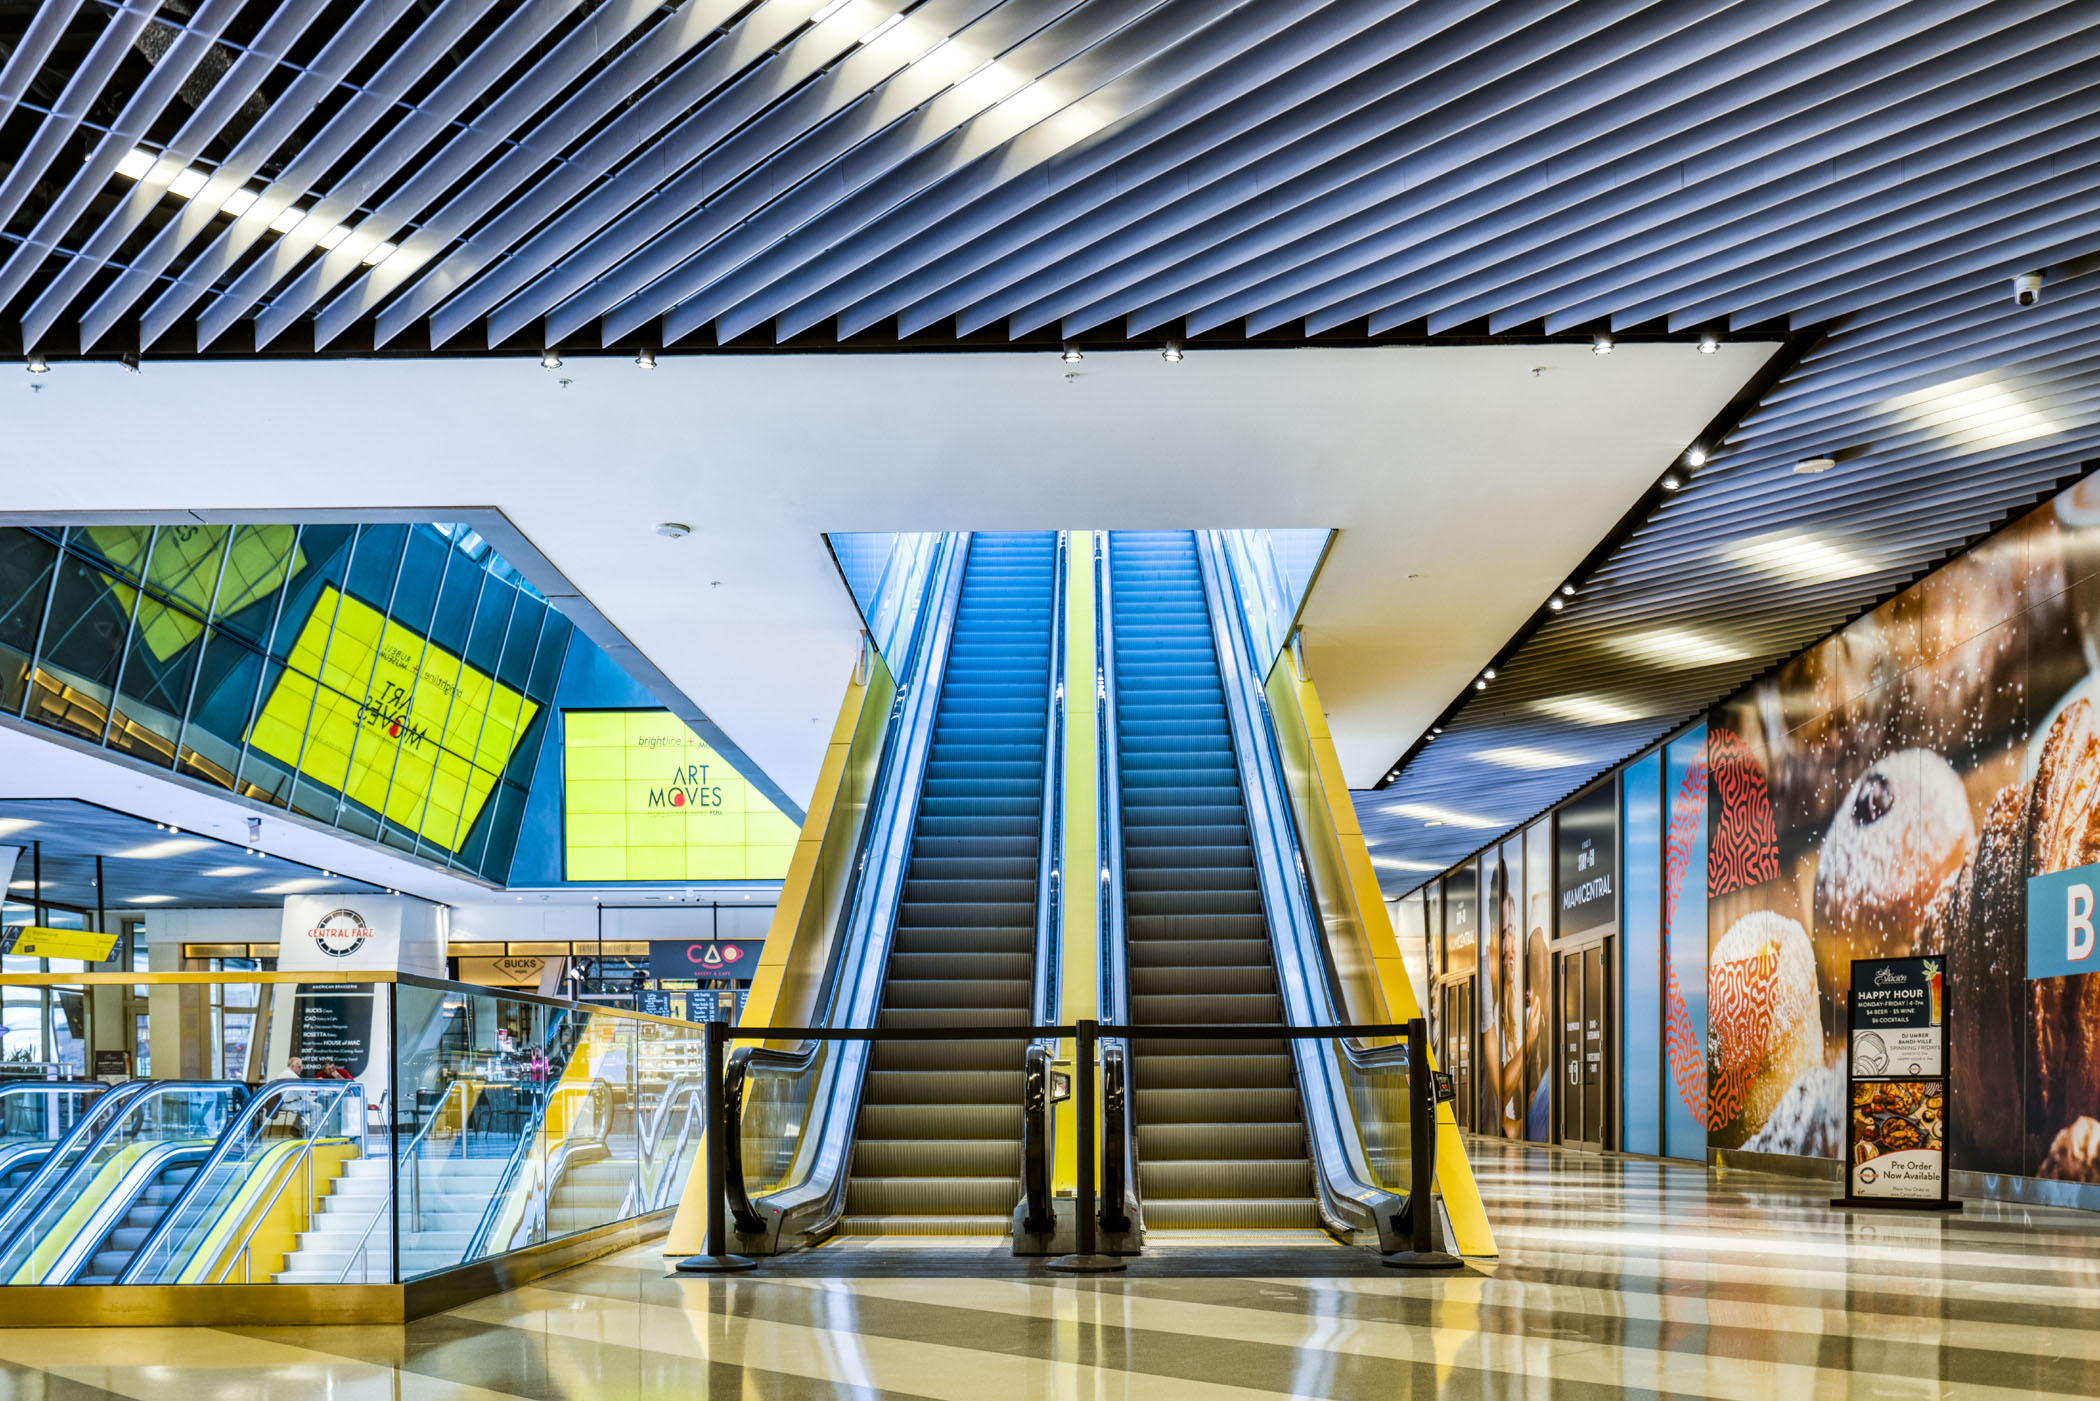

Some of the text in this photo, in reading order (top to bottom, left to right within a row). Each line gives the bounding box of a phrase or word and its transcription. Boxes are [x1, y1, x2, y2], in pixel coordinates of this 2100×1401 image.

[638, 736, 682, 749] brightline
[673, 765, 709, 785] ART
[648, 786, 722, 807] MOVES
[1563, 873, 1612, 910] MIAMICENTRAL
[2066, 883, 2095, 962] B
[308, 928, 374, 938] CENTRAL FARE
[687, 944, 744, 963] CAO
[504, 960, 537, 968] BUCKS
[1858, 989, 1924, 1000] HAPPY HOUR
[1891, 1161, 1932, 1170] Pre Order
[1883, 1171, 1902, 1179] Now
[1904, 1172, 1941, 1181] Available
